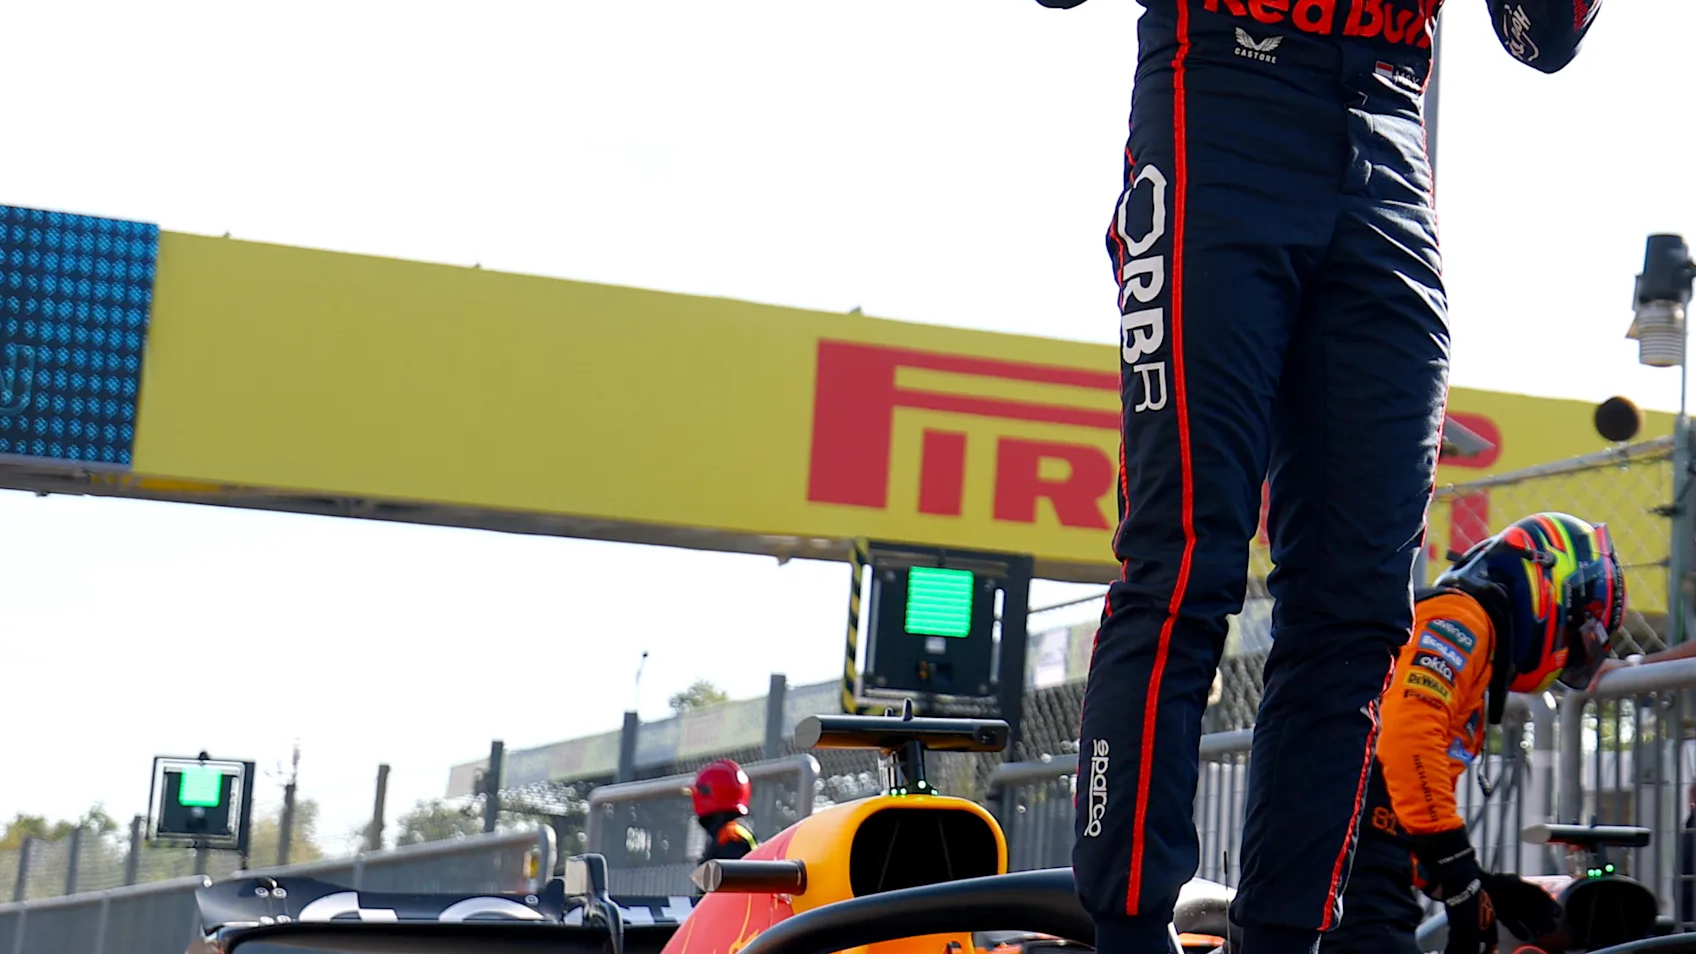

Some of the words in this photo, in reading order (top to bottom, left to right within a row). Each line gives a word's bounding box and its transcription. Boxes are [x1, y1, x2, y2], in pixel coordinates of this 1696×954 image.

[1233, 47, 1278, 65] CASTORE
[1420, 656, 1453, 680] okta
[1084, 738, 1109, 837] sparco
